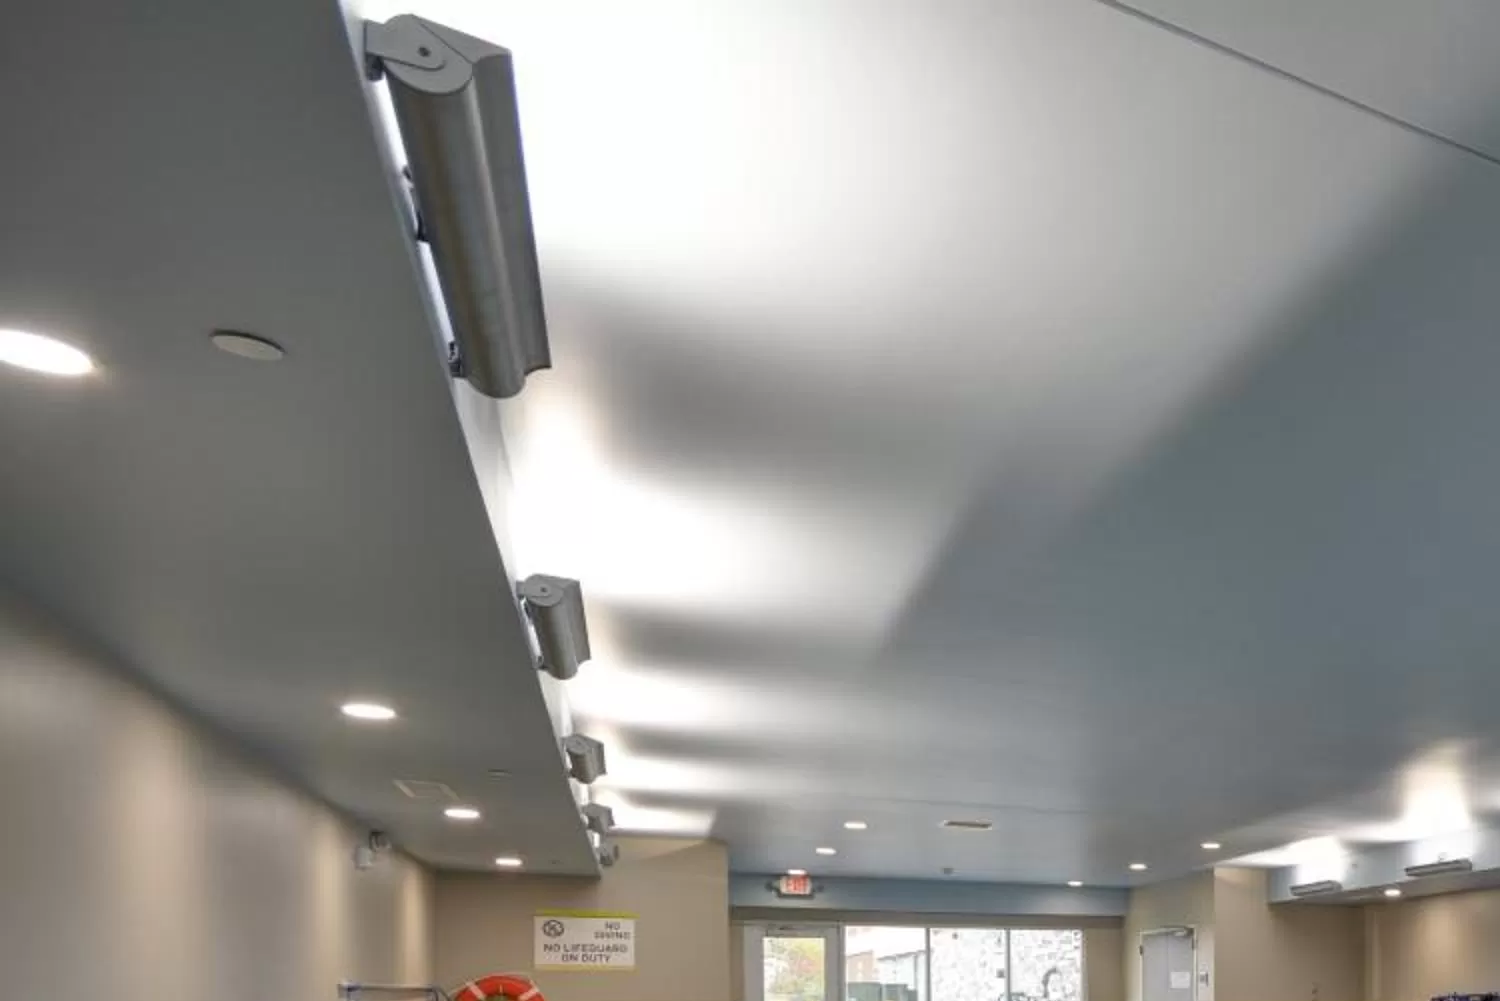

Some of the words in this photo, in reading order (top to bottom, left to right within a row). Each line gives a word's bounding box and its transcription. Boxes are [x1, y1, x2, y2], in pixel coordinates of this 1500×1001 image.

[543, 943, 561, 952] NO
[561, 953, 578, 962] ON
[582, 953, 611, 962] DUTY
